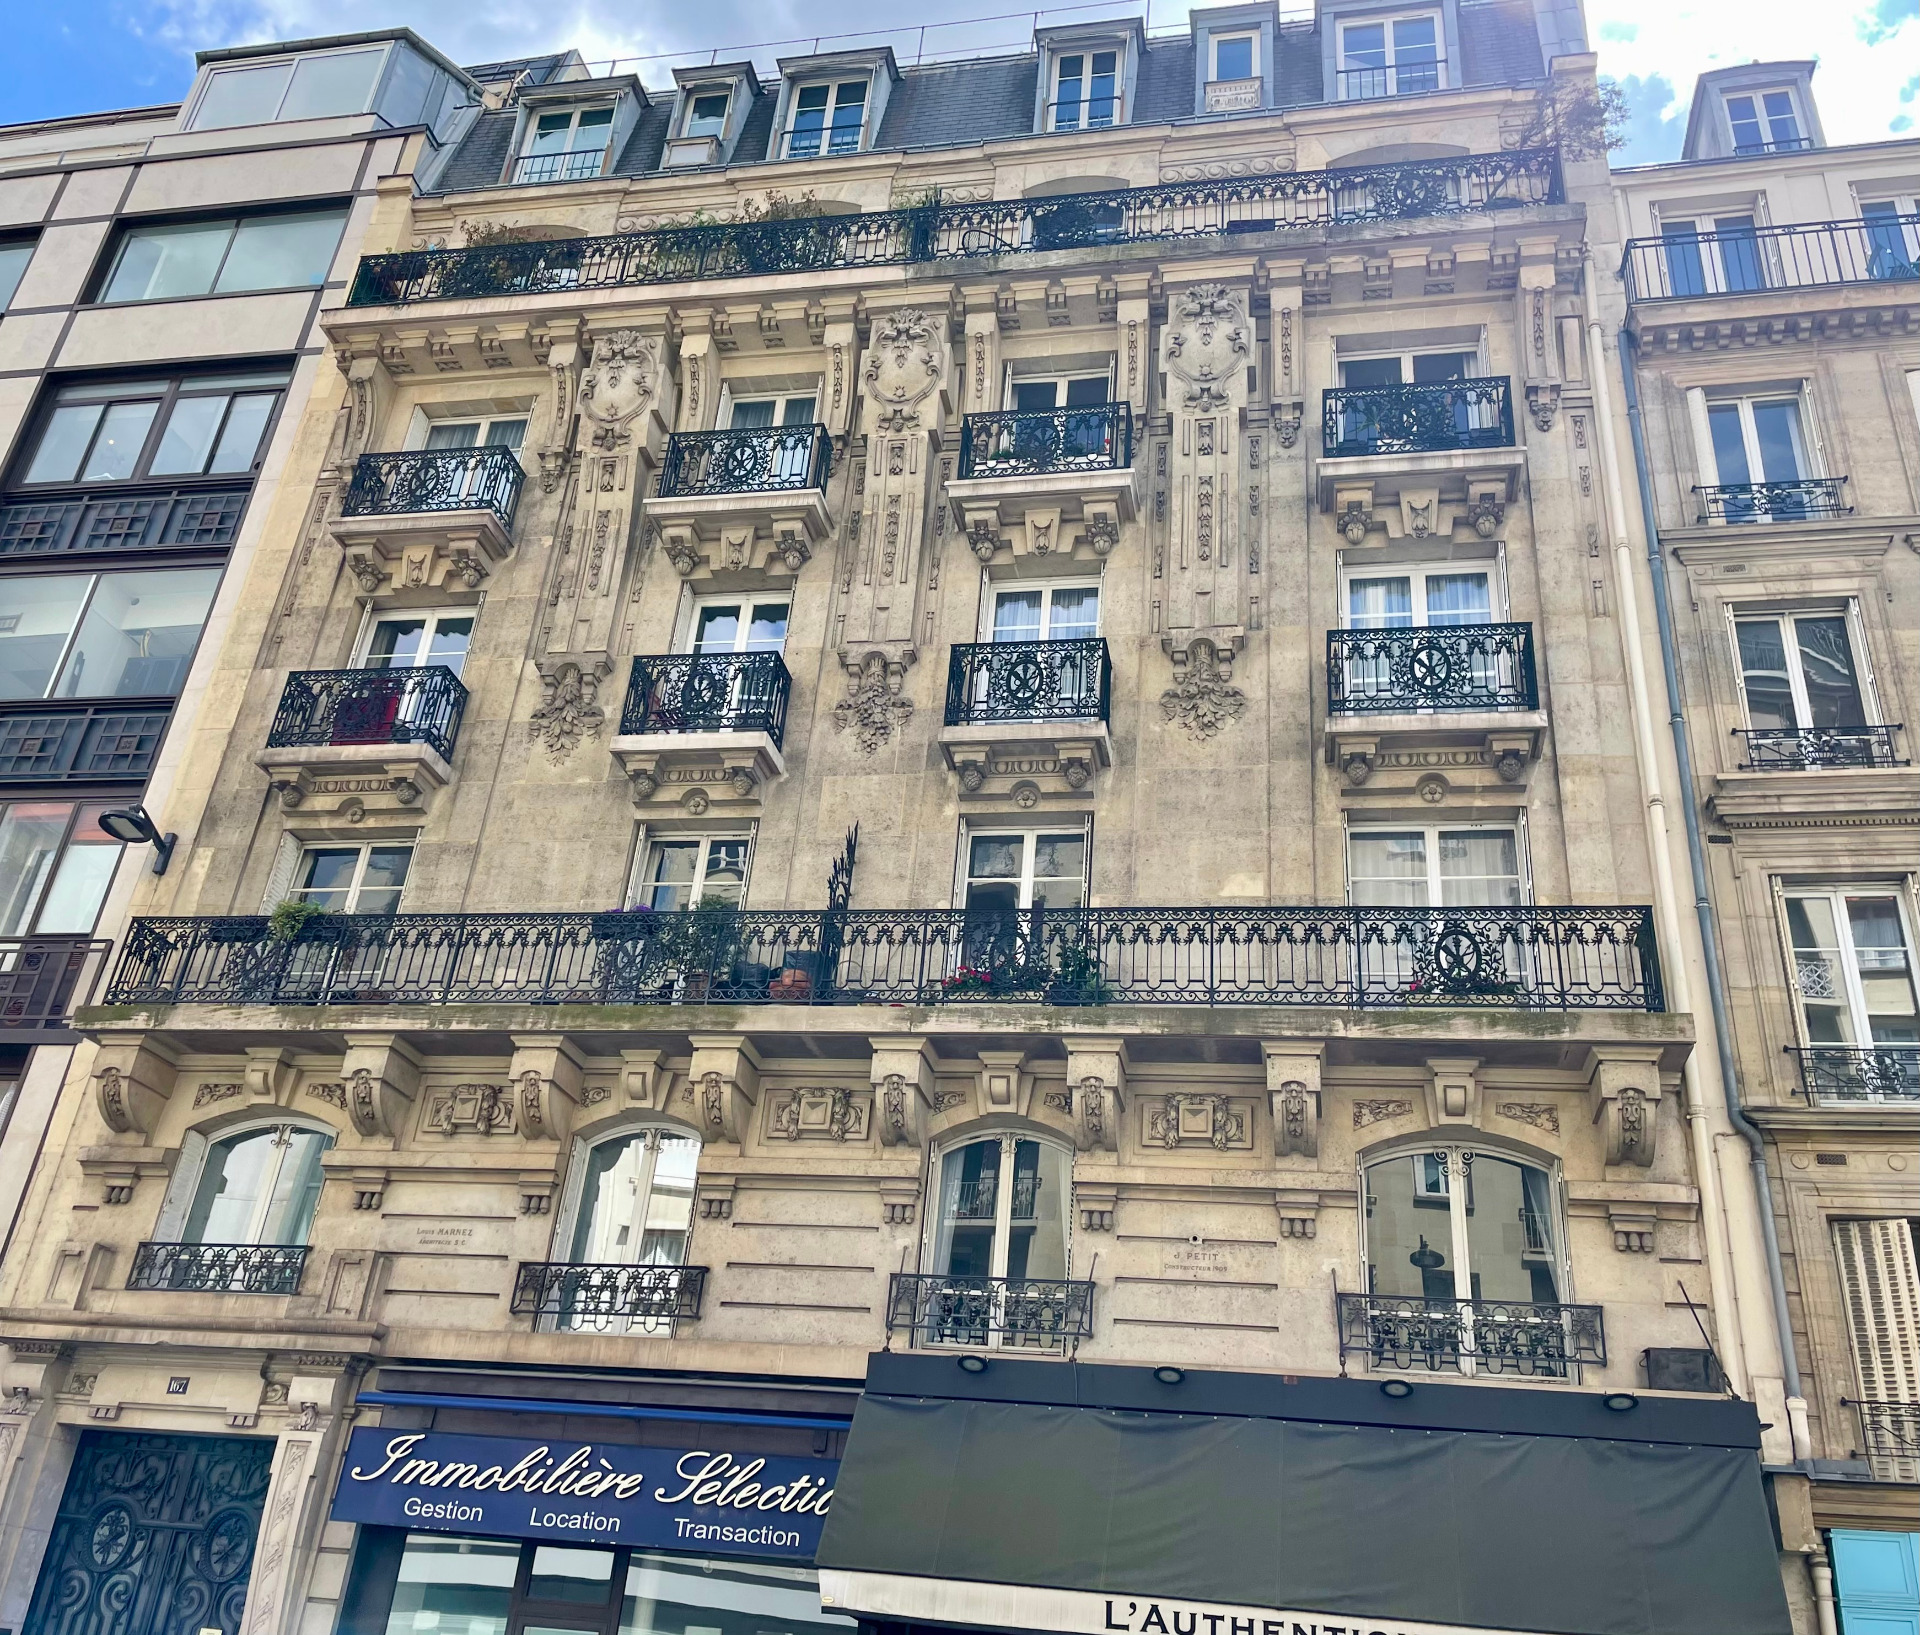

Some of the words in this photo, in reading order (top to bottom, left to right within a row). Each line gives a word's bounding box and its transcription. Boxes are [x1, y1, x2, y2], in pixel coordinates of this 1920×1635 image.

[437, 1228, 473, 1237] MARNEZ
[1186, 1252, 1219, 1261] PETIT
[169, 1380, 187, 1392] 167
[351, 1434, 644, 1499] Immobilière
[404, 1497, 483, 1522] Gestion
[529, 1507, 621, 1532] Location
[674, 1517, 800, 1547] Transaction
